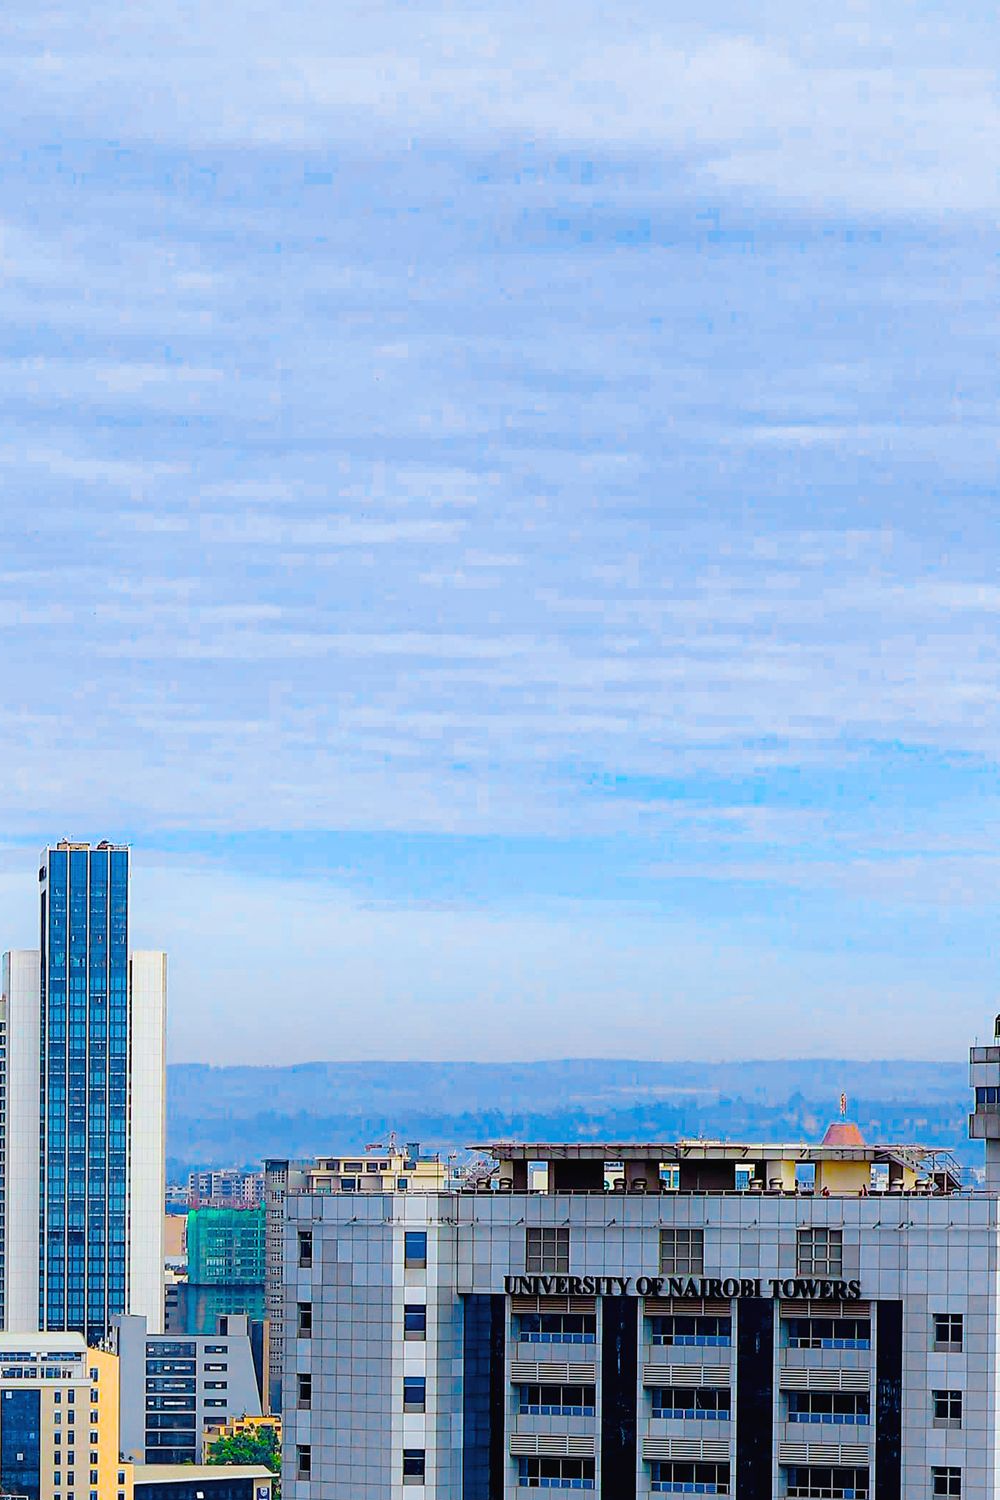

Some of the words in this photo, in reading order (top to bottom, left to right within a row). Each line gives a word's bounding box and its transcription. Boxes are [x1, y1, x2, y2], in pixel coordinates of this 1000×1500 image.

[504, 1275, 631, 1295] UNIVERSITY
[636, 1276, 663, 1296] OF
[668, 1277, 763, 1298] NAIROBI
[769, 1279, 861, 1299] TOWERS
